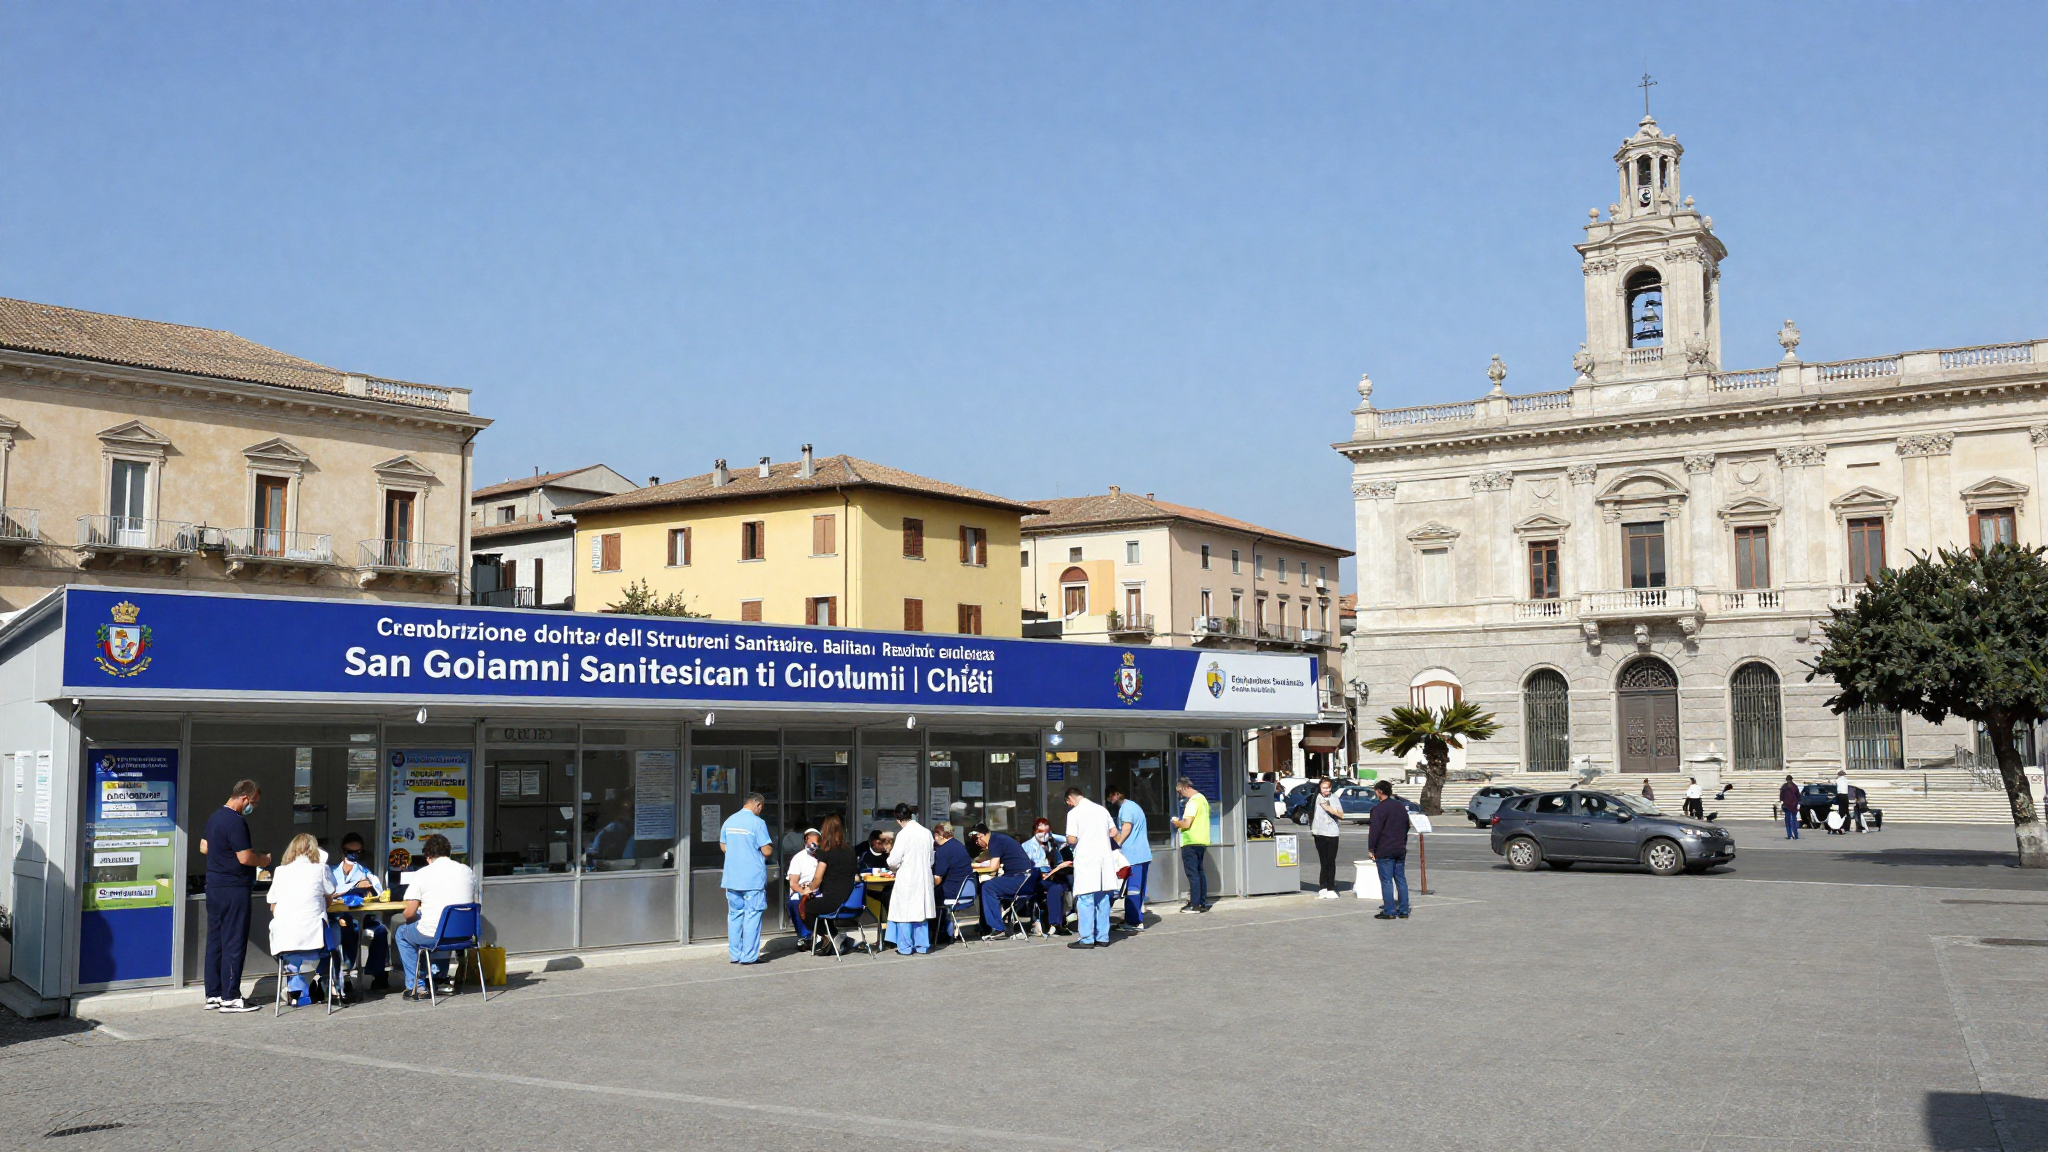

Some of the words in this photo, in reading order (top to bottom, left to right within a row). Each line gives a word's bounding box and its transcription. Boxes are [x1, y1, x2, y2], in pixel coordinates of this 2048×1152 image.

[604, 628, 642, 647] dell
[344, 646, 411, 678] San
[423, 649, 570, 682] Goiamni
[579, 655, 749, 687] Sanitesican
[755, 660, 775, 688] ti
